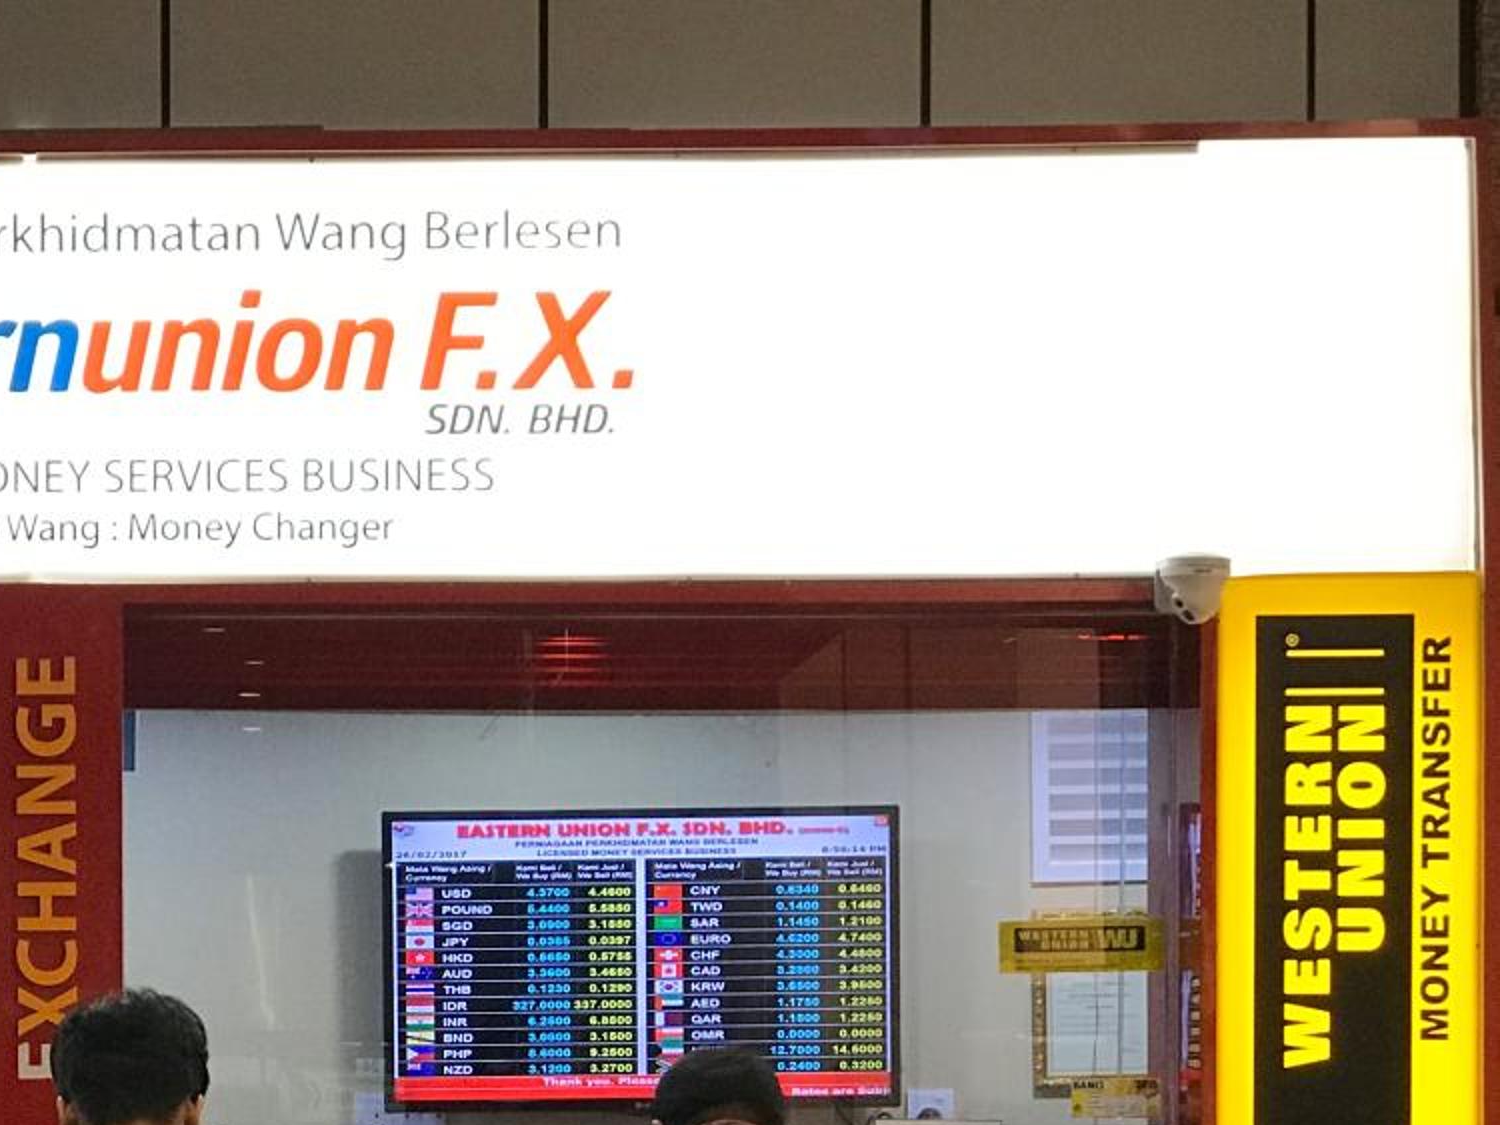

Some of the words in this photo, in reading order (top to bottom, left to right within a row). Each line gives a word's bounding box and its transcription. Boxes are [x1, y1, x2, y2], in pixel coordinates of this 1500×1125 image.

[276, 212, 406, 261] Wang
[425, 209, 621, 250] Berlesen
[420, 290, 634, 391] F.X.
[425, 403, 510, 434] SDN.
[528, 403, 614, 434] BHD.
[104, 459, 288, 493] SERVICES
[303, 458, 495, 492] BUSINESS
[8, 513, 99, 549] Wang
[128, 512, 241, 549] Money
[252, 512, 394, 548] Changer
[1420, 636, 1452, 862] TRANSFER
[457, 824, 550, 838] EASTERN
[558, 823, 630, 837] UNION
[637, 822, 677, 836] F.X.
[683, 821, 732, 836] SDN.
[739, 820, 793, 835] BHD.
[1337, 705, 1386, 953] UNION
[15, 655, 79, 1080] EXCHANGE
[690, 886, 720, 896] CNY
[1283, 705, 1333, 1069] WESTERN
[442, 889, 472, 899] USD
[526, 887, 570, 897] 4.3700
[442, 905, 493, 915] POUND
[690, 901, 722, 911] TWD
[776, 900, 819, 910] 0.1400
[442, 921, 473, 931] SGD
[690, 917, 719, 927] SAR
[442, 937, 469, 947] JPY
[690, 933, 731, 943] EURO
[1018, 929, 1089, 941] WESTERN
[1101, 928, 1139, 949] WU
[442, 953, 473, 963] HKD
[691, 949, 720, 959] CHF
[1420, 887, 1451, 1041] MONEY
[443, 969, 473, 979] AUD
[691, 965, 720, 975] CAD
[443, 985, 472, 995] THB
[691, 981, 725, 991] KRW
[443, 1001, 468, 1011] IDR
[691, 997, 720, 1007] AED
[443, 1017, 468, 1027] INR
[691, 1013, 721, 1023] QAR
[443, 1033, 474, 1043] BND
[691, 1029, 725, 1039] OMR
[444, 1049, 472, 1059] PHP
[444, 1065, 473, 1075] NZD
[542, 1076, 581, 1087] Thank
